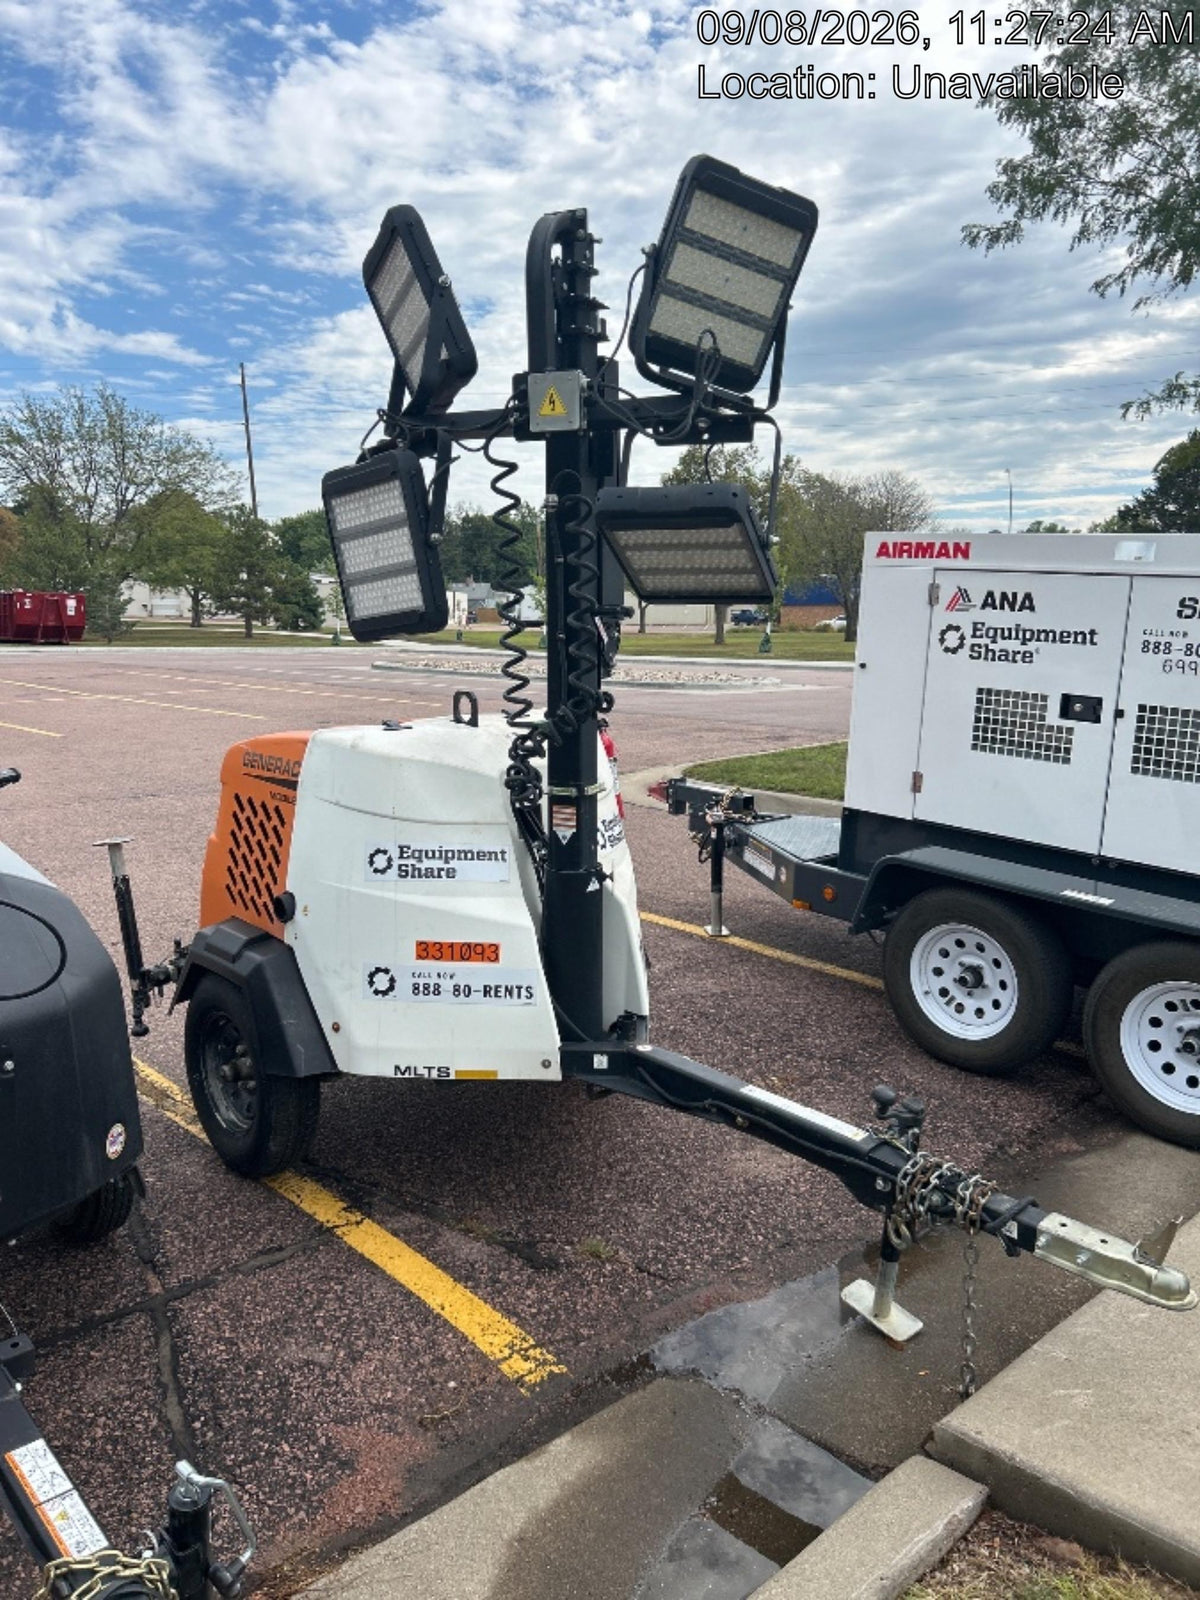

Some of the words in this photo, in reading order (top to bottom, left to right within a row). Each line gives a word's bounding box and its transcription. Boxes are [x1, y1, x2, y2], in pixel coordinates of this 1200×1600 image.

[876, 541, 970, 560] AIRMAN
[980, 590, 1036, 612] ANA
[1177, 596, 1200, 619] S
[971, 621, 1099, 646] Equipment
[969, 643, 1035, 664] Share
[242, 751, 302, 778] GENERAC
[398, 845, 507, 864] Equipment
[398, 863, 457, 879] Share
[417, 941, 500, 962] 331093
[411, 971, 432, 979] CALL
[436, 972, 456, 980] NOW
[394, 1064, 451, 1078] MLTS
